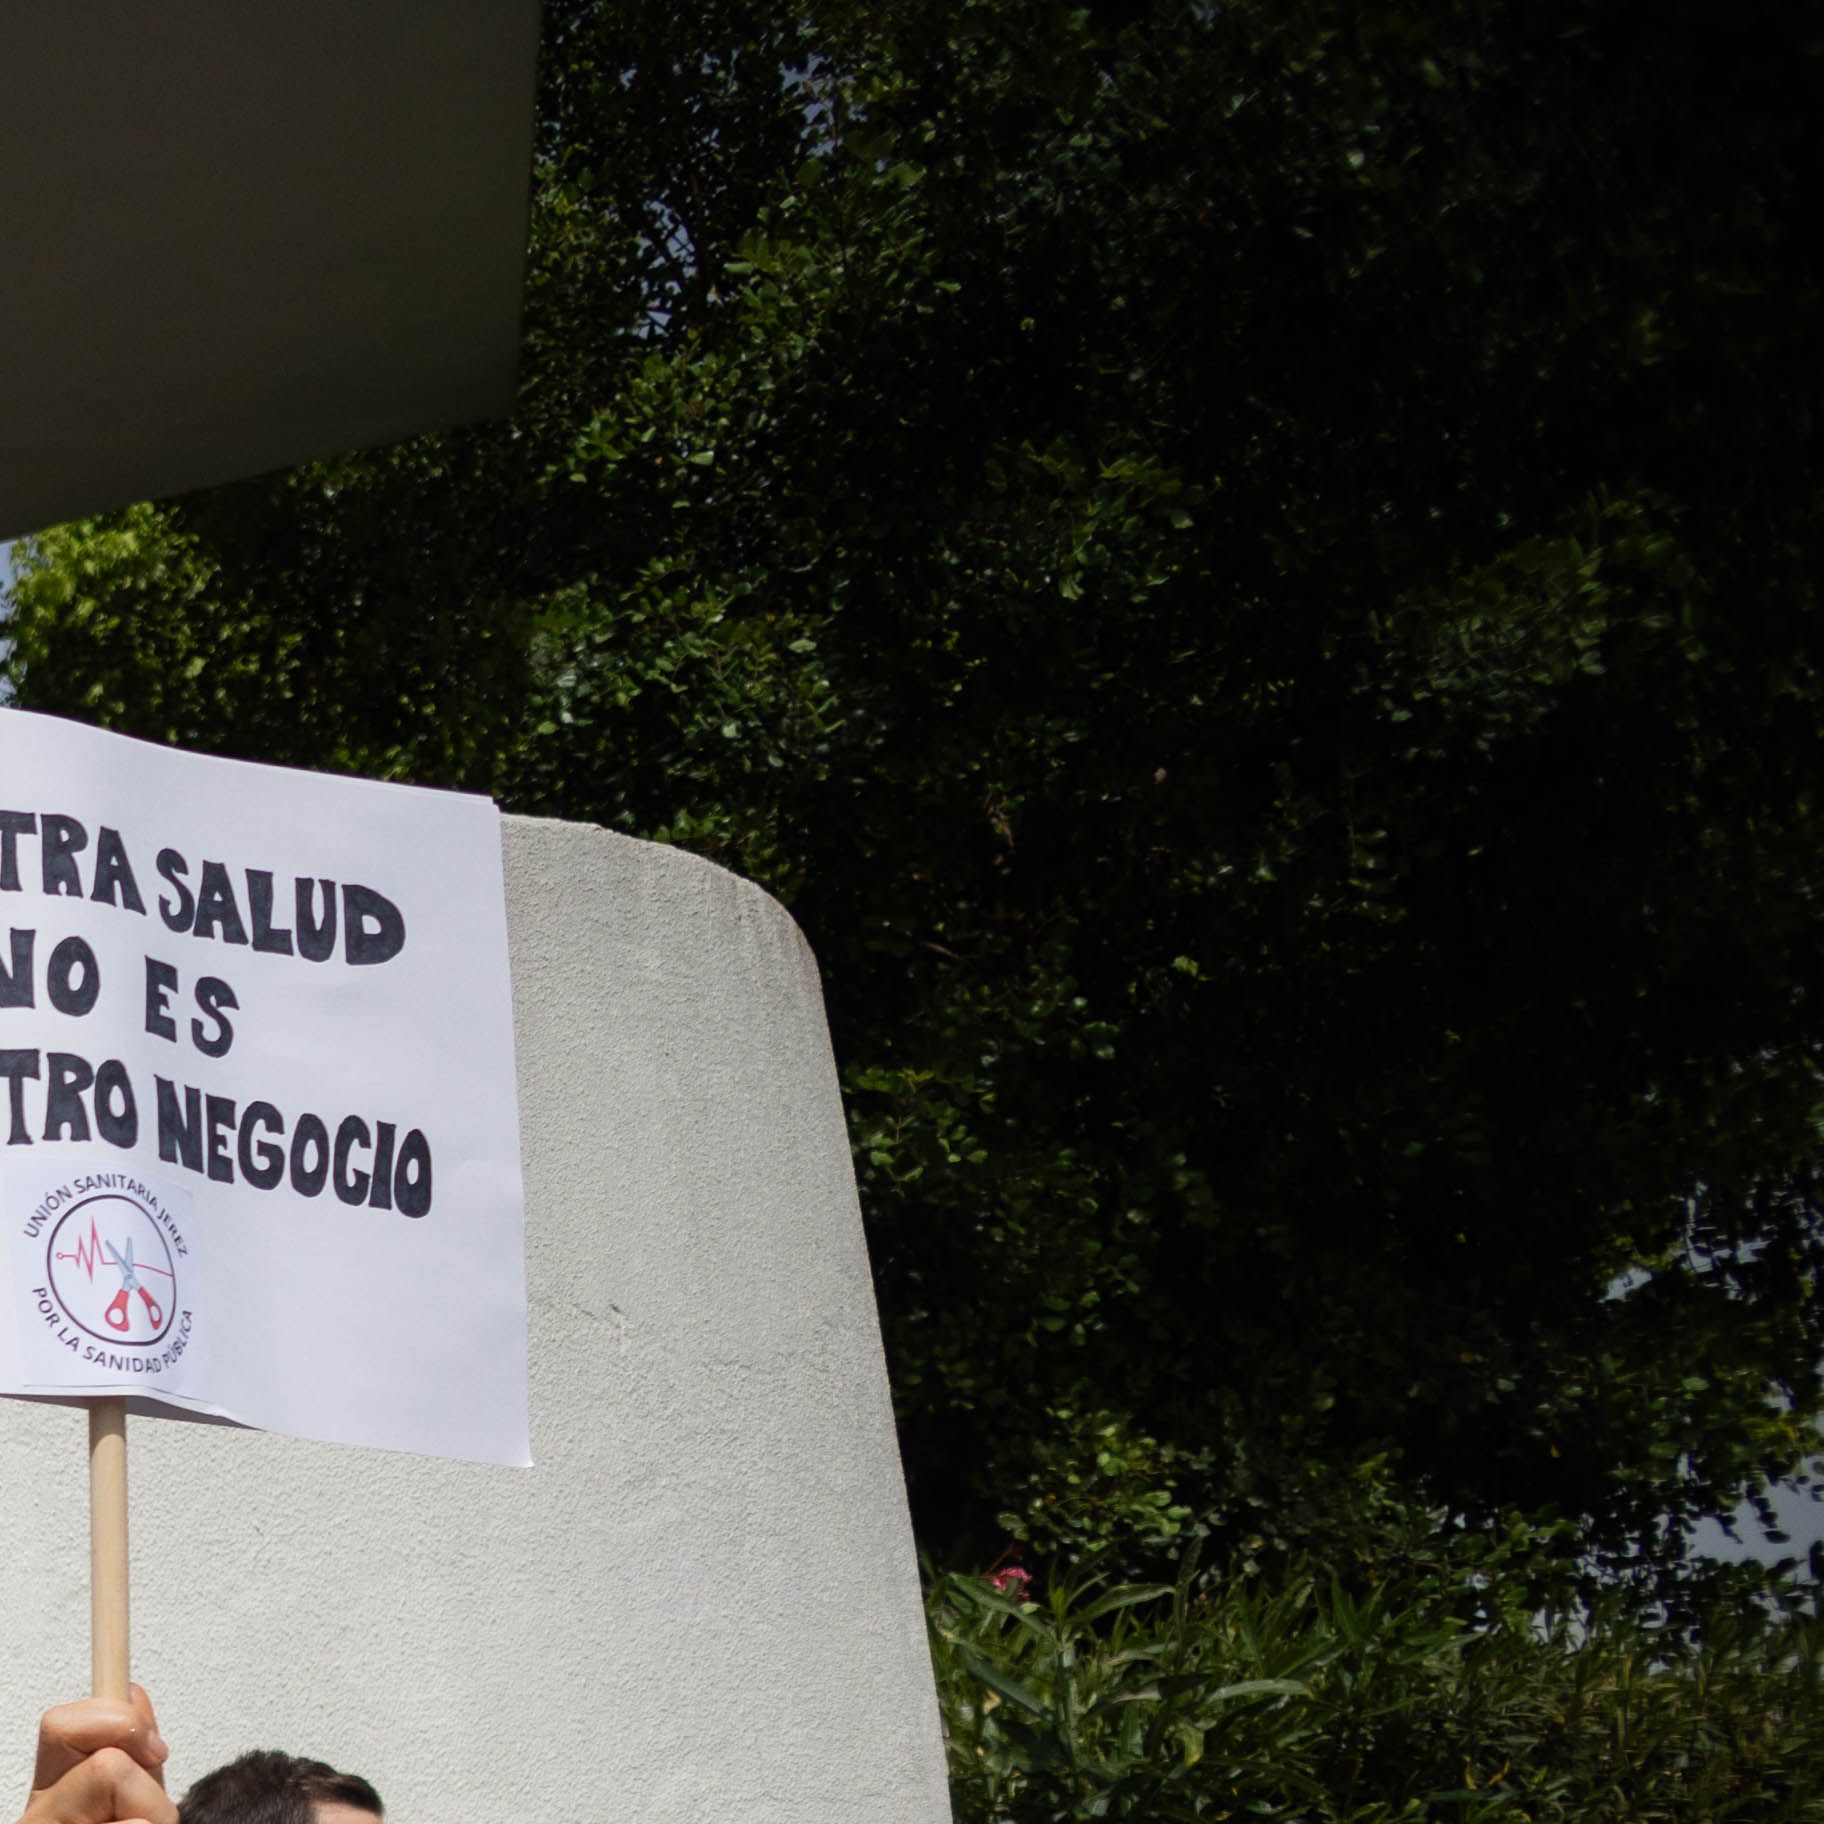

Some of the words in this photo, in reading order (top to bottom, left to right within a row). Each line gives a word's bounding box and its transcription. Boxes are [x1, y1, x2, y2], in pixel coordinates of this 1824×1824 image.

[155, 847, 406, 965] SALUD
[144, 956, 240, 1058] ES
[155, 1074, 434, 1219] NEGOCIO
[24, 1185, 73, 1238] UNIÓN
[74, 1173, 159, 1213] SANITARIA
[156, 1208, 189, 1259] JEREZ
[32, 1287, 60, 1329] POR
[57, 1327, 80, 1352] LA
[82, 1346, 162, 1374] SANIDAD
[162, 1309, 192, 1370] PÚBLICA
